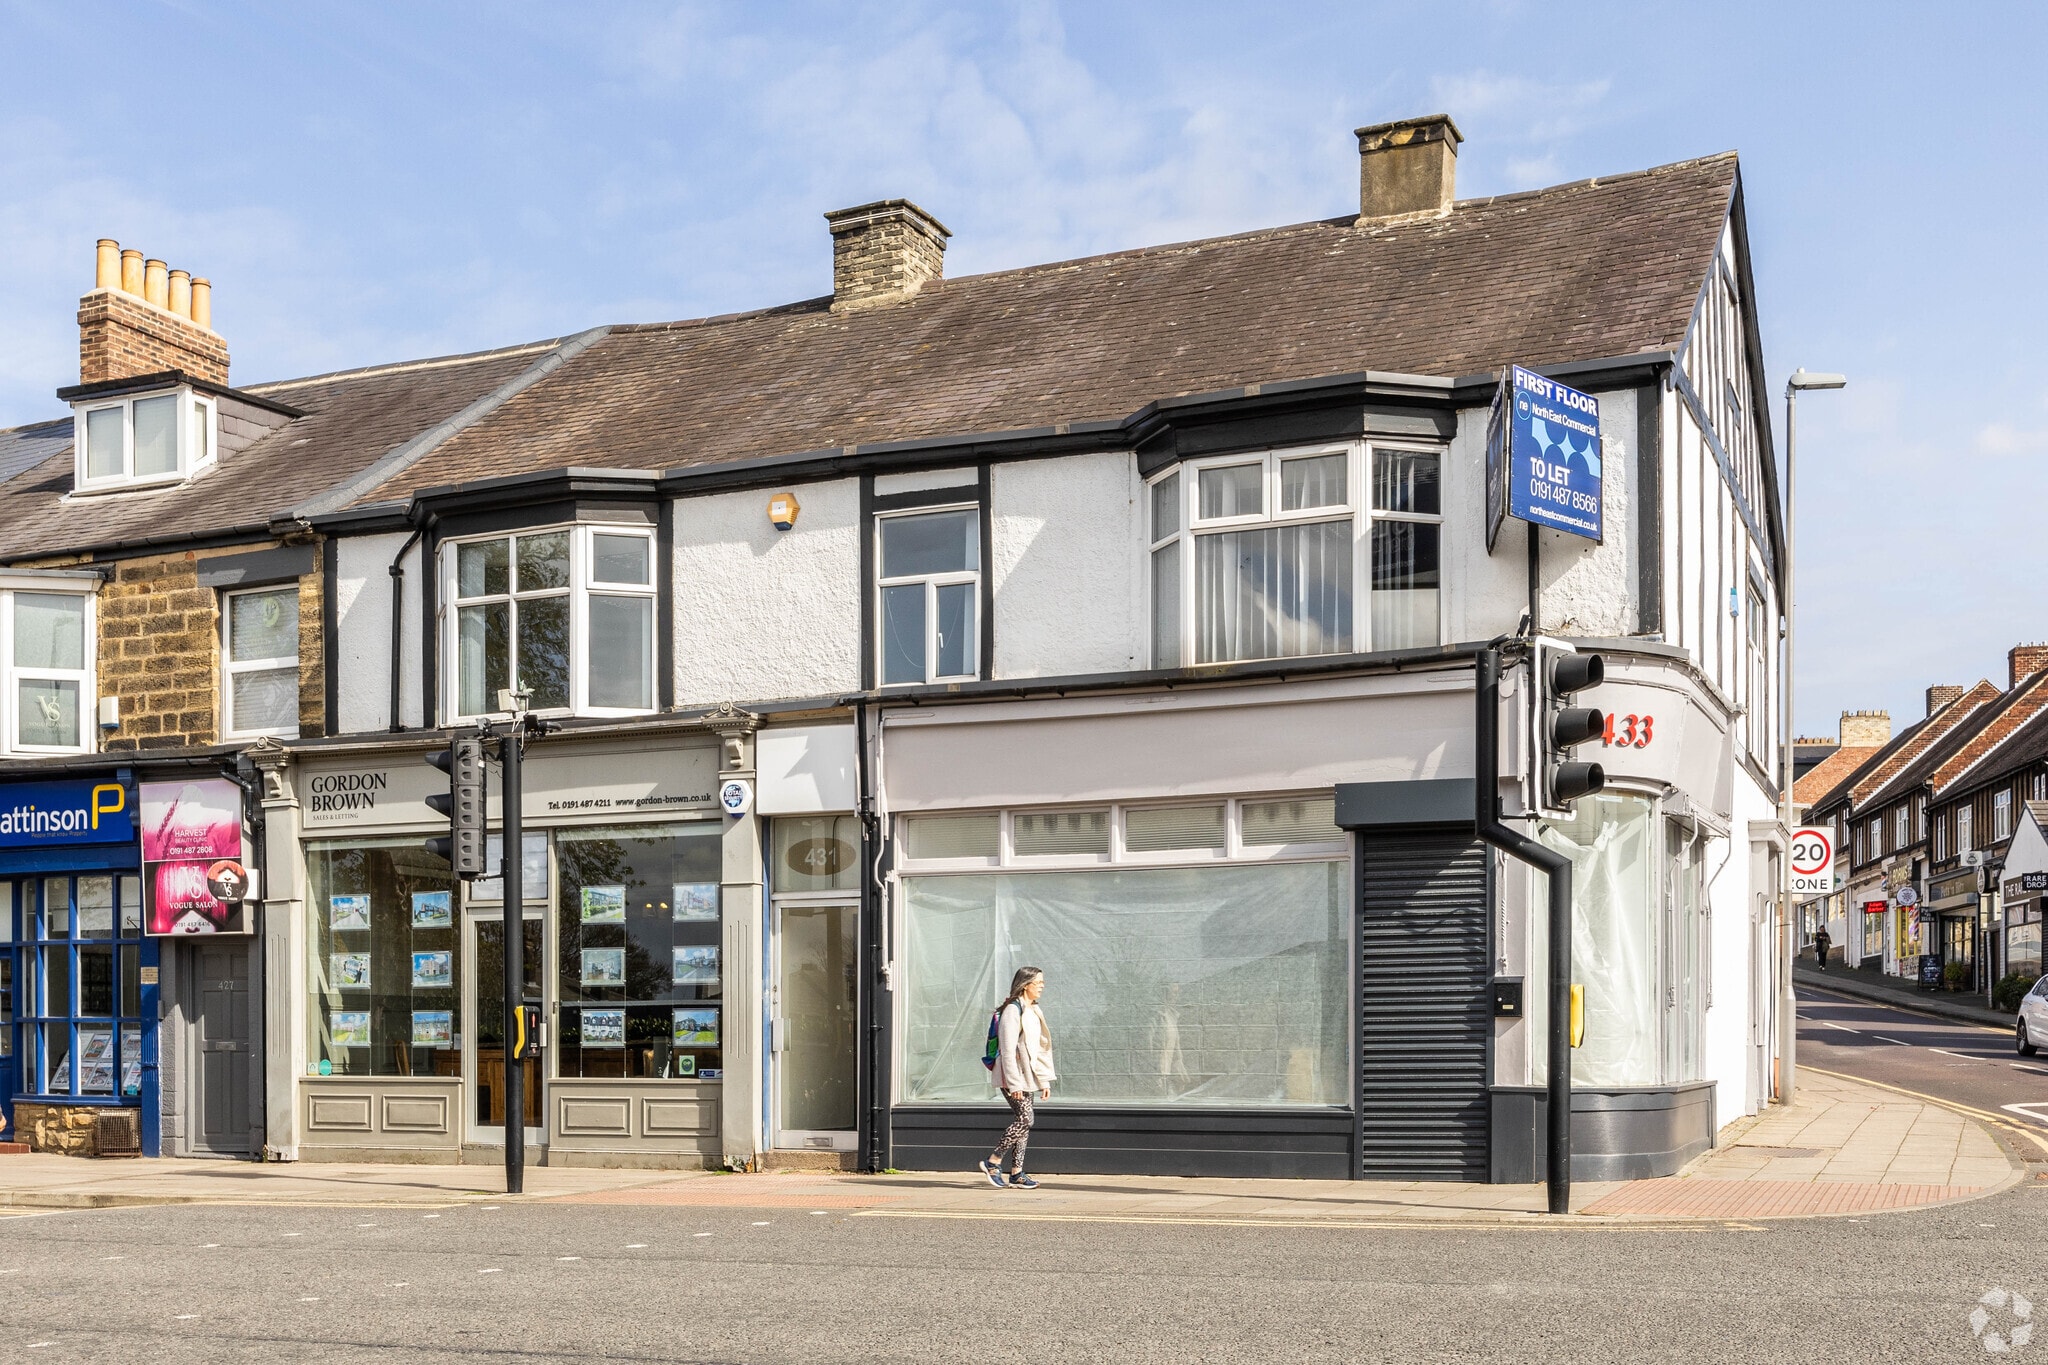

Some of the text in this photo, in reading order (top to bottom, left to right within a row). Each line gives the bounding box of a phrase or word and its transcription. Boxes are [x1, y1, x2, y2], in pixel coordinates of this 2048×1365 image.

[1516, 369, 1598, 416] FIRST FLOOR
[1519, 400, 1528, 412] ne
[1532, 402, 1596, 437] North East Commercial
[1530, 456, 1571, 486] TO LET
[1530, 478, 1598, 514] 0191 487 8566
[1601, 713, 1654, 747] 433
[311, 772, 387, 793] GORDON
[311, 792, 376, 812] BROWN
[562, 800, 580, 809] 0191
[580, 799, 593, 808] 487
[594, 798, 611, 807] 4211
[615, 792, 711, 807] www.gordon-brown.co.uk
[174, 828, 207, 837] HARVEST
[169, 847, 183, 855] 0191
[804, 847, 836, 866] 431
[1793, 843, 1824, 861] 20
[2005, 884, 2014, 898] THE
[195, 900, 218, 908] SALON
[218, 980, 234, 990] 427
